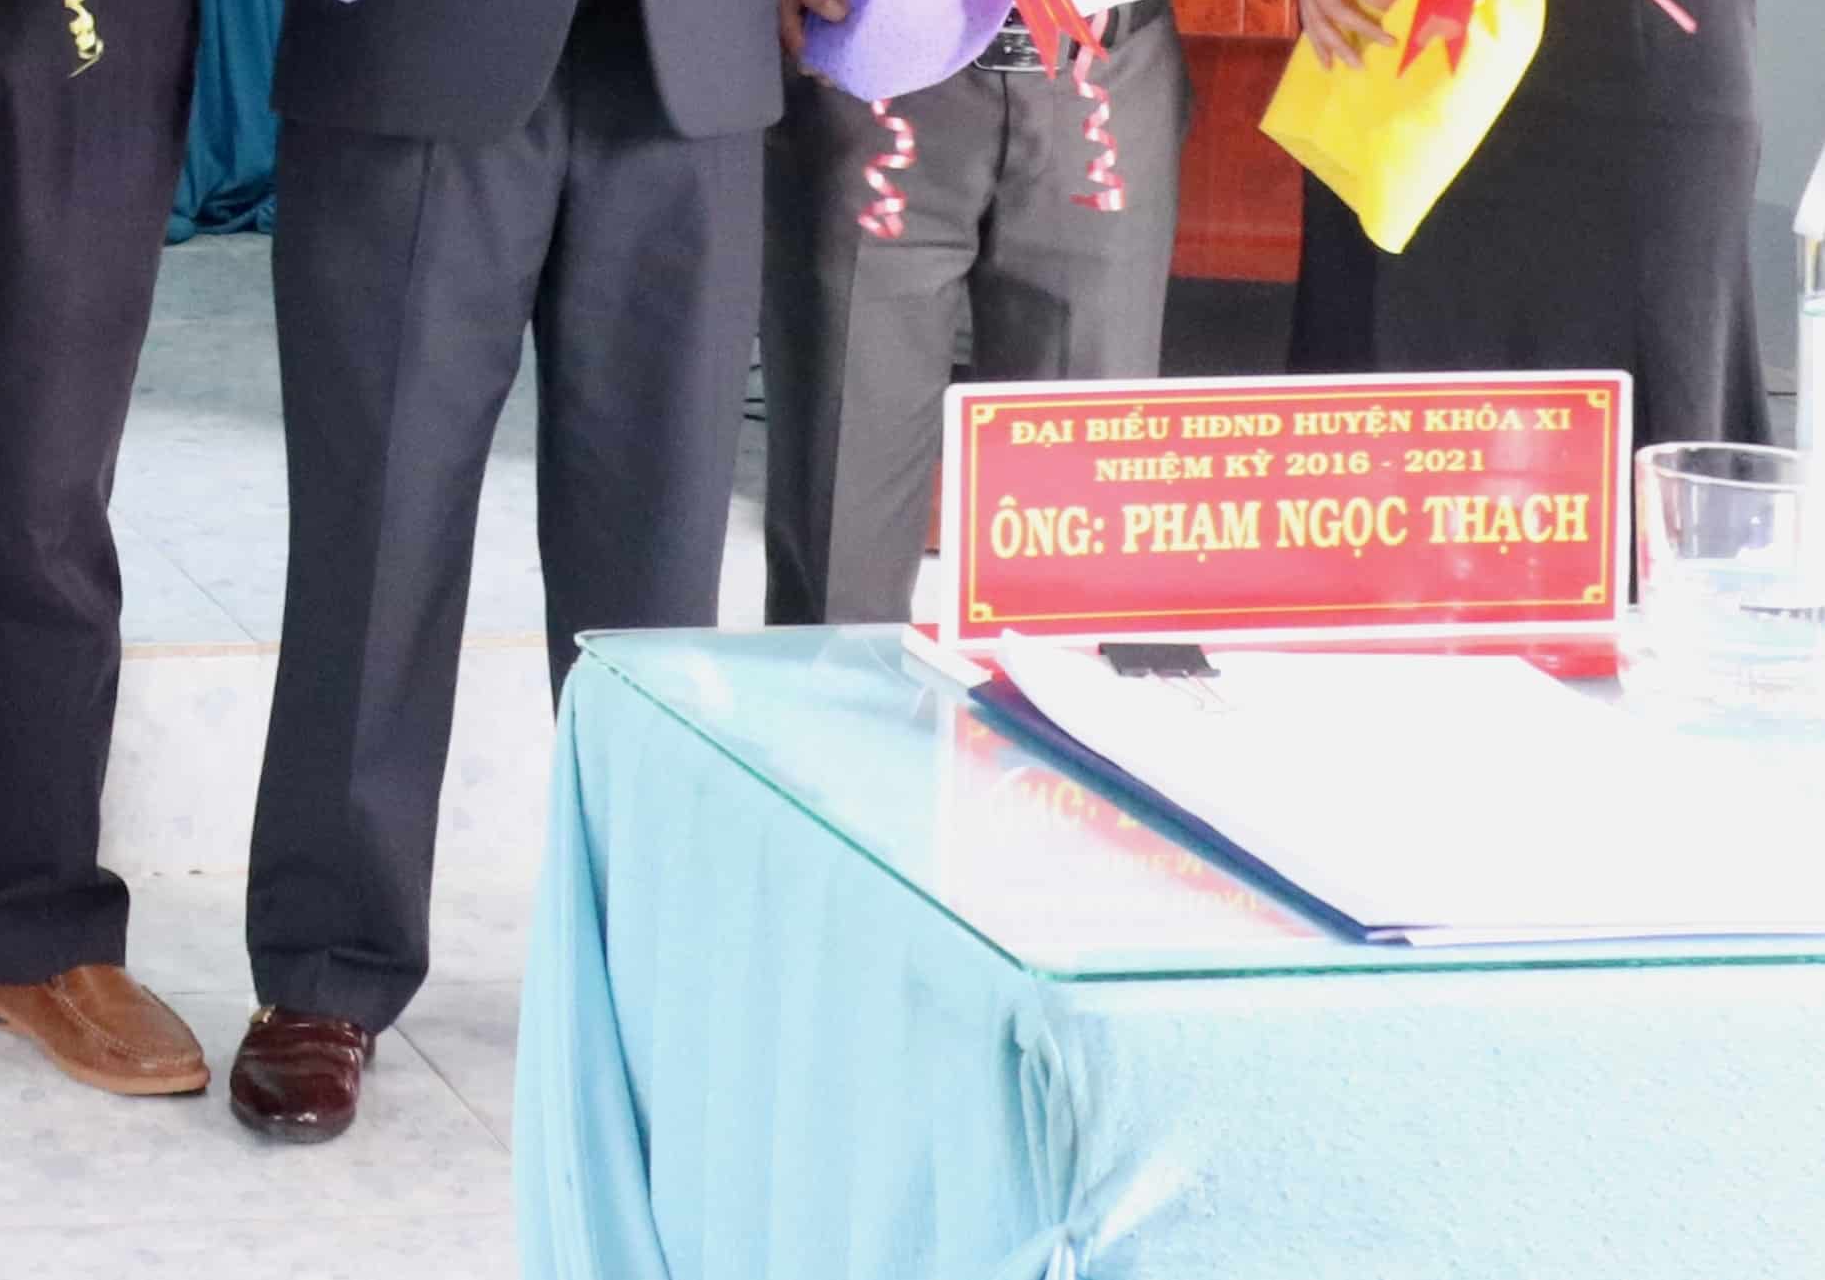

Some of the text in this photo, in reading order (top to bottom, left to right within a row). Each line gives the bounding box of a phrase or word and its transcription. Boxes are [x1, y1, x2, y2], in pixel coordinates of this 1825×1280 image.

[1011, 403, 1571, 447] ĐẠI BIỂU HĐND HUYỆN KHÓA XI
[1095, 451, 1213, 484] NHIỆM
[1285, 450, 1370, 476] 2016
[1404, 449, 1485, 472] 2021
[991, 493, 1590, 562] ÔNG: PHẠM NGỌC THẠCH
